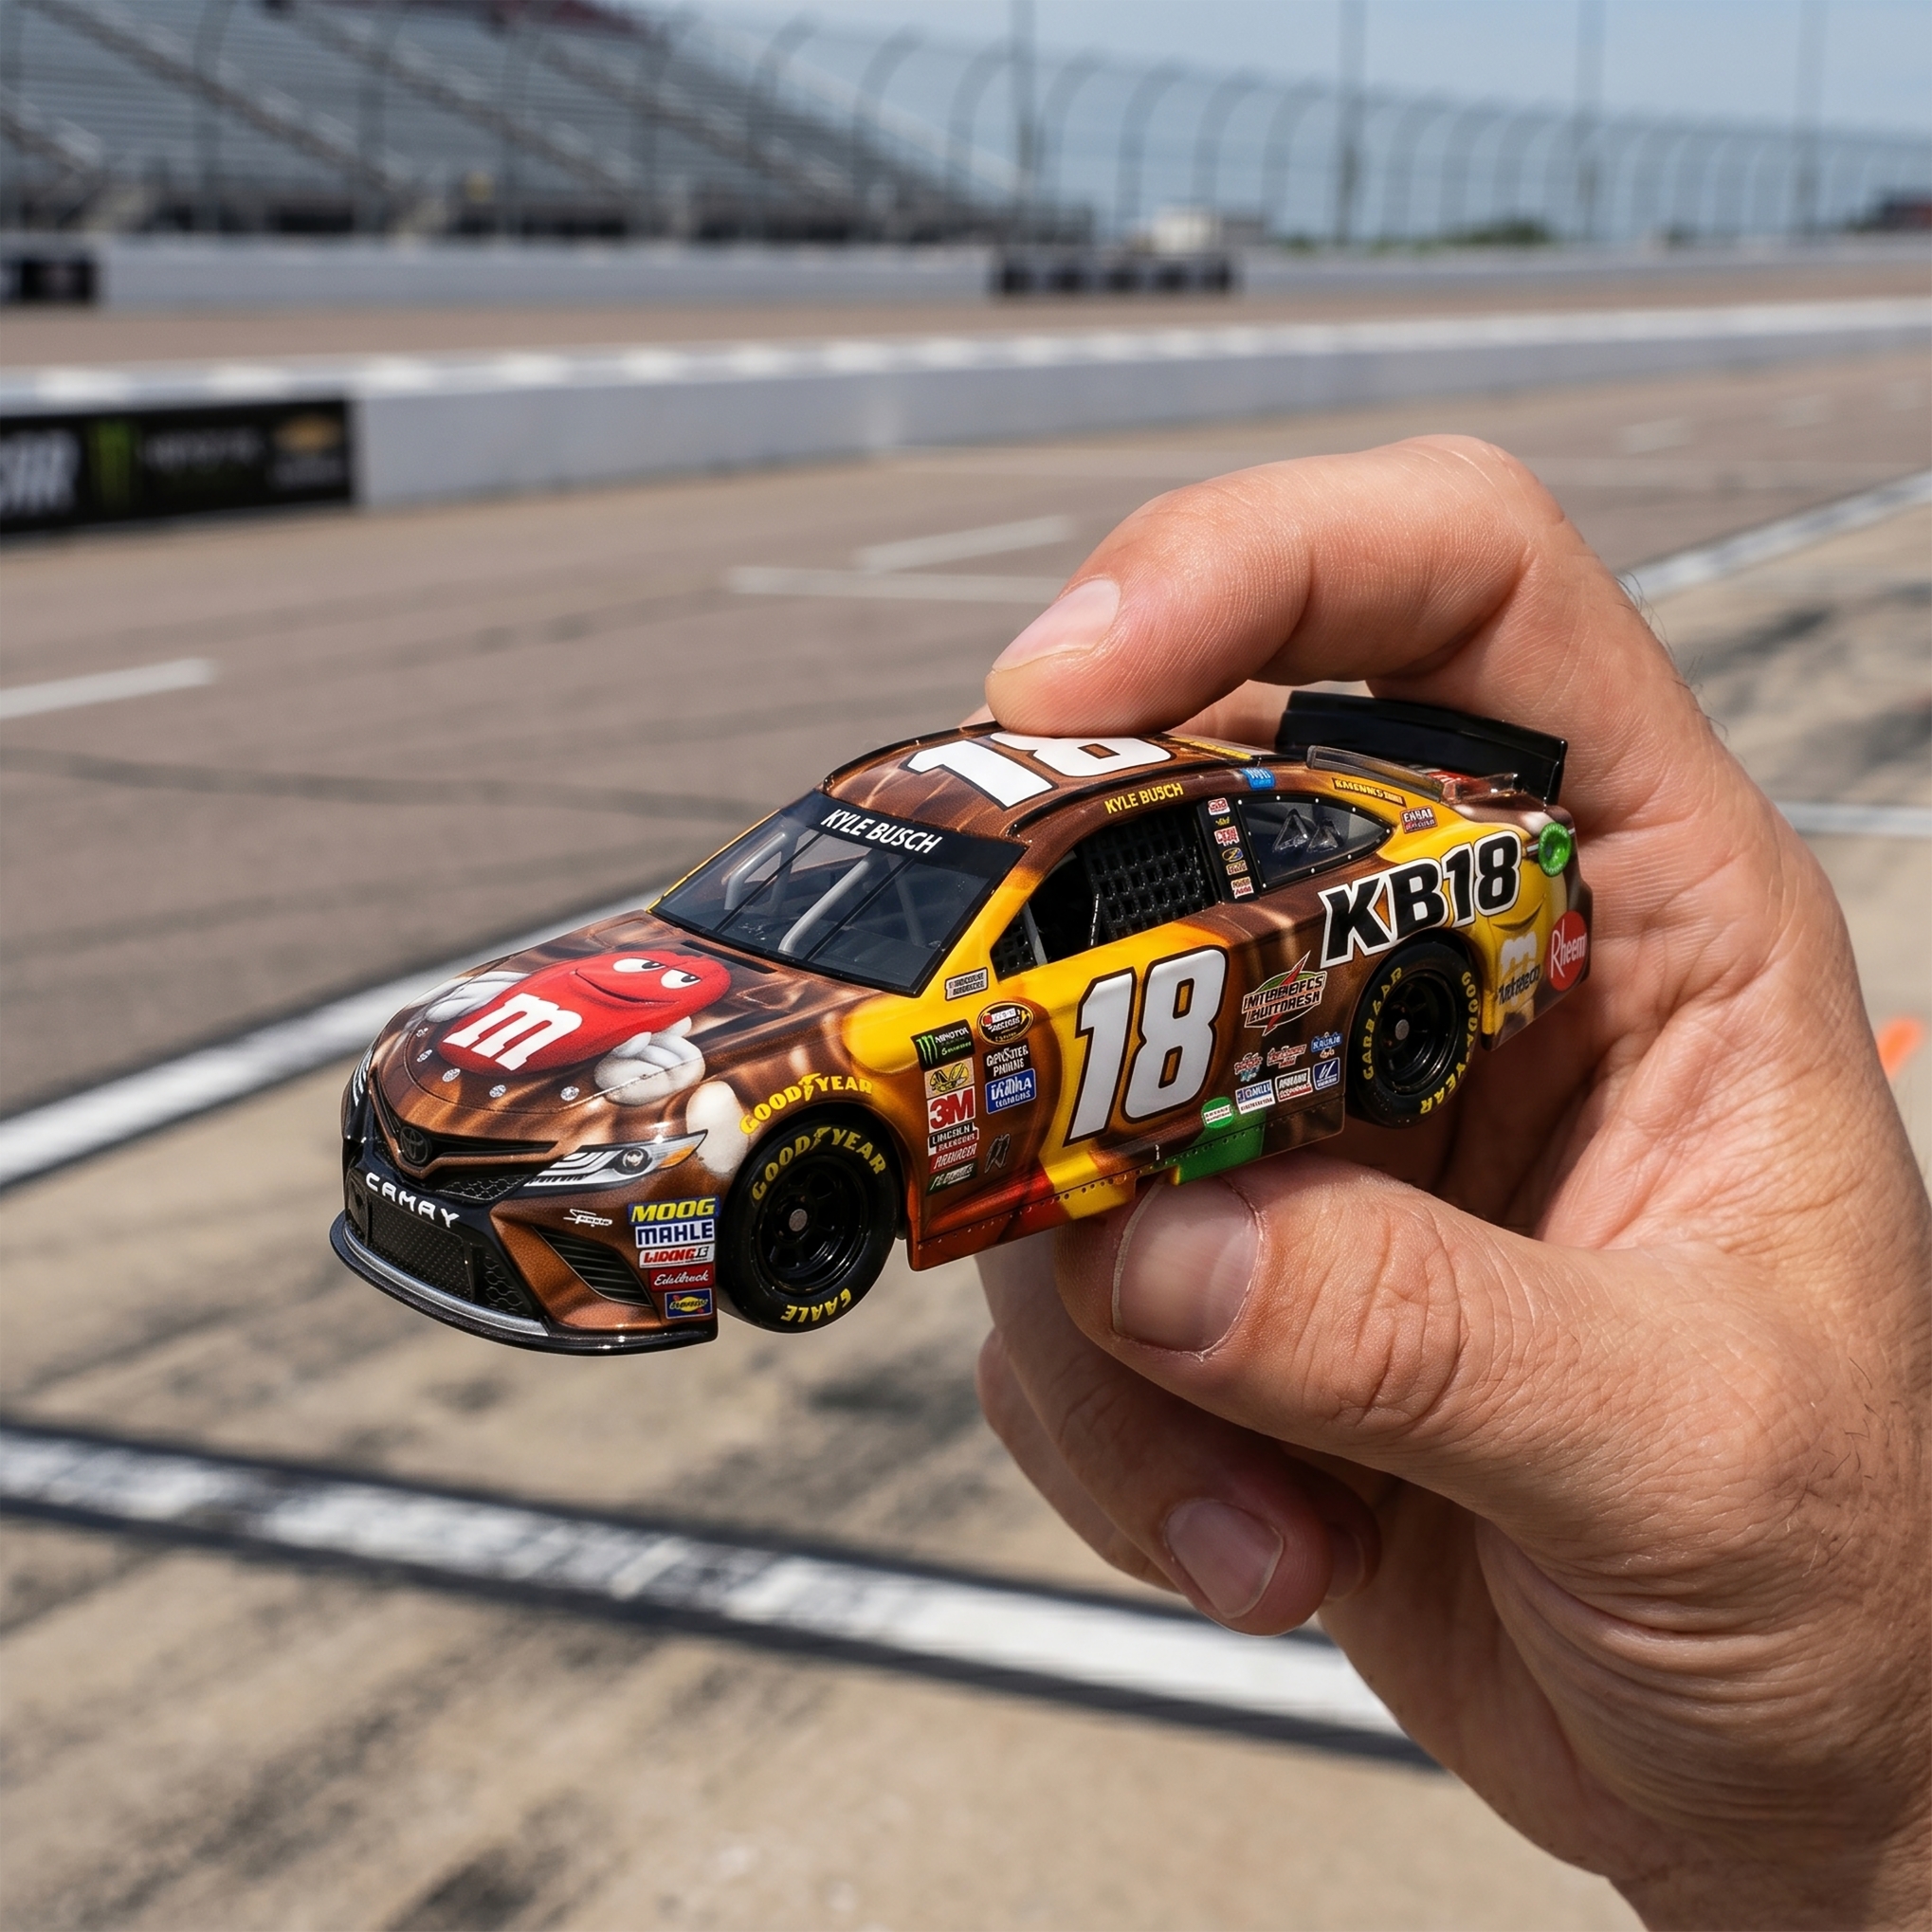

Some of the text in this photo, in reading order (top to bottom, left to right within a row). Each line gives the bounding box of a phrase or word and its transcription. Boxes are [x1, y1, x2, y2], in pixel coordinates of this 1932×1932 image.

[1104, 782, 1184, 814] KYLE BUSCH
[820, 809, 943, 854] KYLE BUSCH
[1319, 830, 1522, 969] KB18
[1550, 918, 1588, 979] Rheem
[1066, 948, 1228, 1142] 18
[739, 1073, 873, 1135] GOODYEAR
[929, 1089, 975, 1130] 3M
[631, 1197, 716, 1223] MOOG
[637, 1222, 713, 1246] MAHLE
